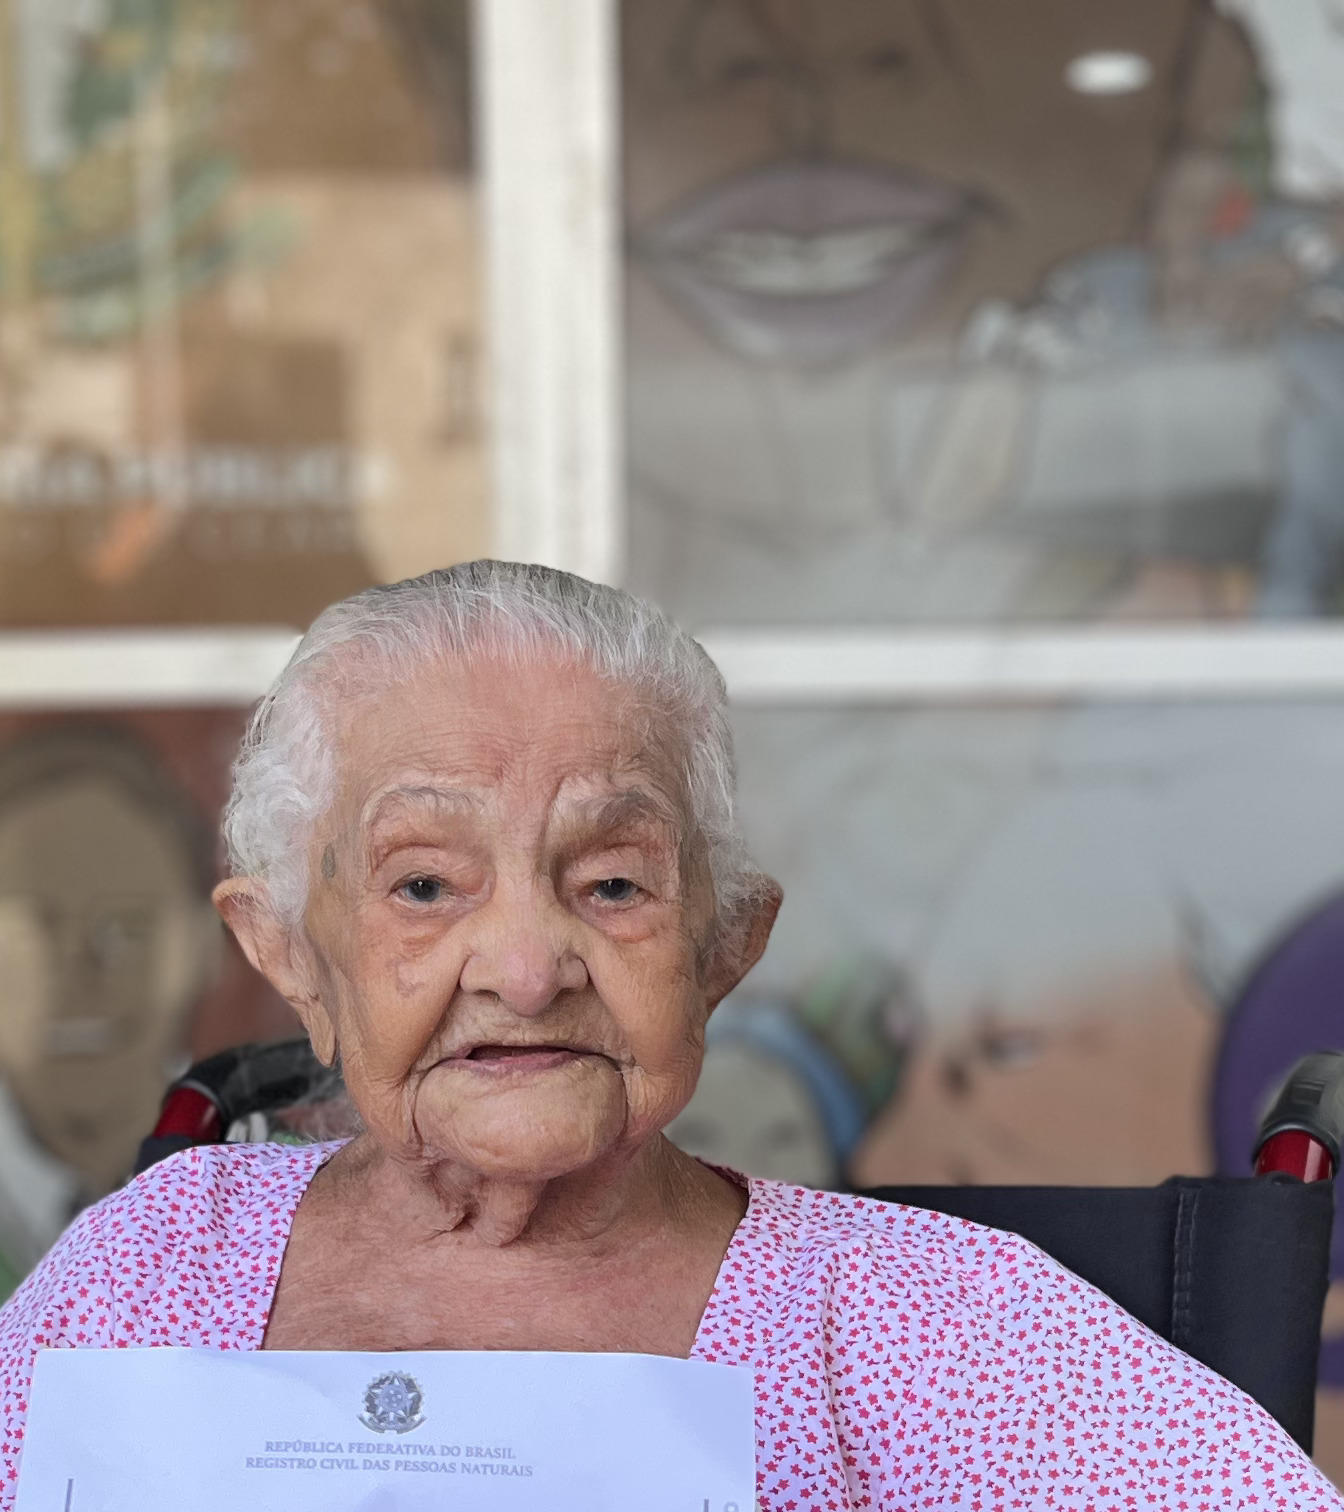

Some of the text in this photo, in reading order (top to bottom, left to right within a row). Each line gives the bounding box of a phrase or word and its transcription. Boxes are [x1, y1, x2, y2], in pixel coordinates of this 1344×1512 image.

[265, 1440, 516, 1459] REPÚBLICA FEDERATIVA DO BRASIL
[246, 1457, 533, 1476] REGISTRO CIVIL DAS PESSOAS NATURAIS
